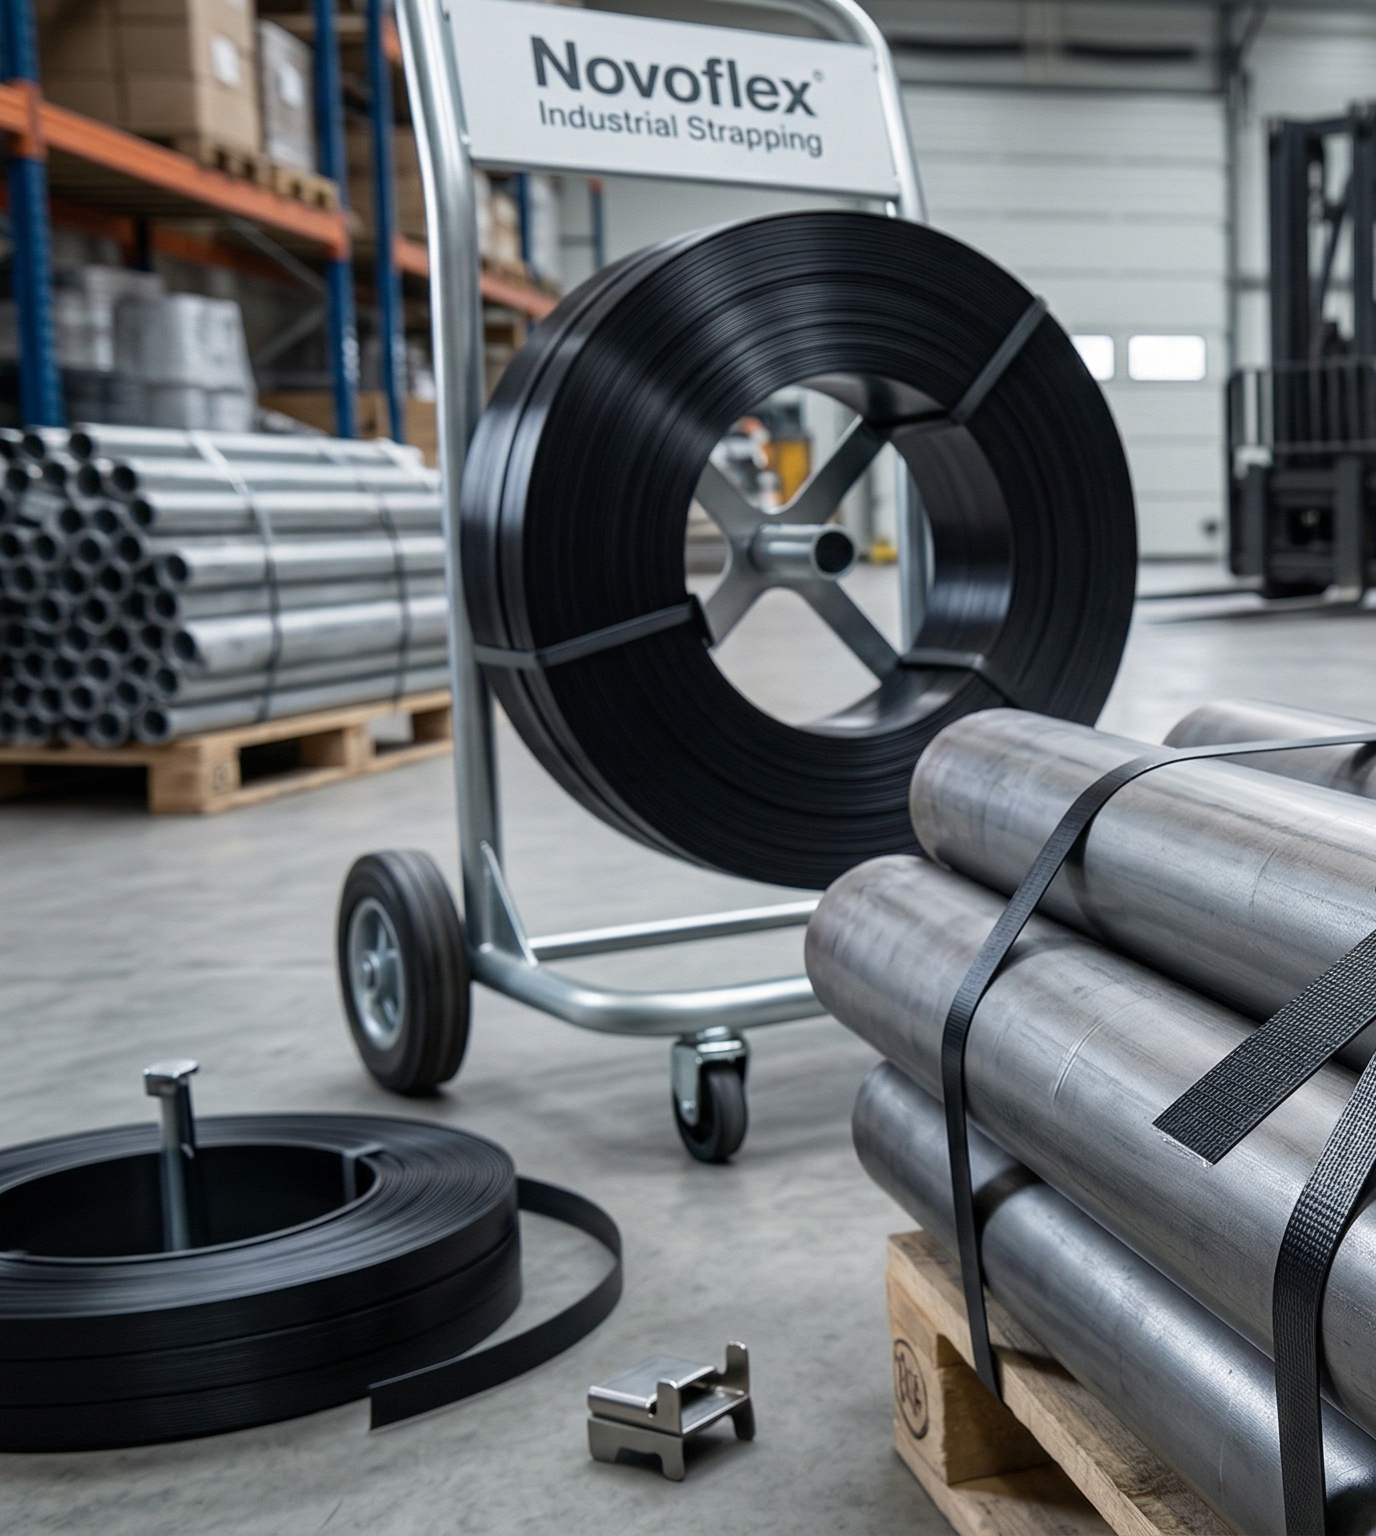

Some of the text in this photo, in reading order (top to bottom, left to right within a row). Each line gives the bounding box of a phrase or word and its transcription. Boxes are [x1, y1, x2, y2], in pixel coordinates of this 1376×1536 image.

[530, 35, 817, 117] Novoflex
[538, 100, 823, 158] Industrial Strapping
